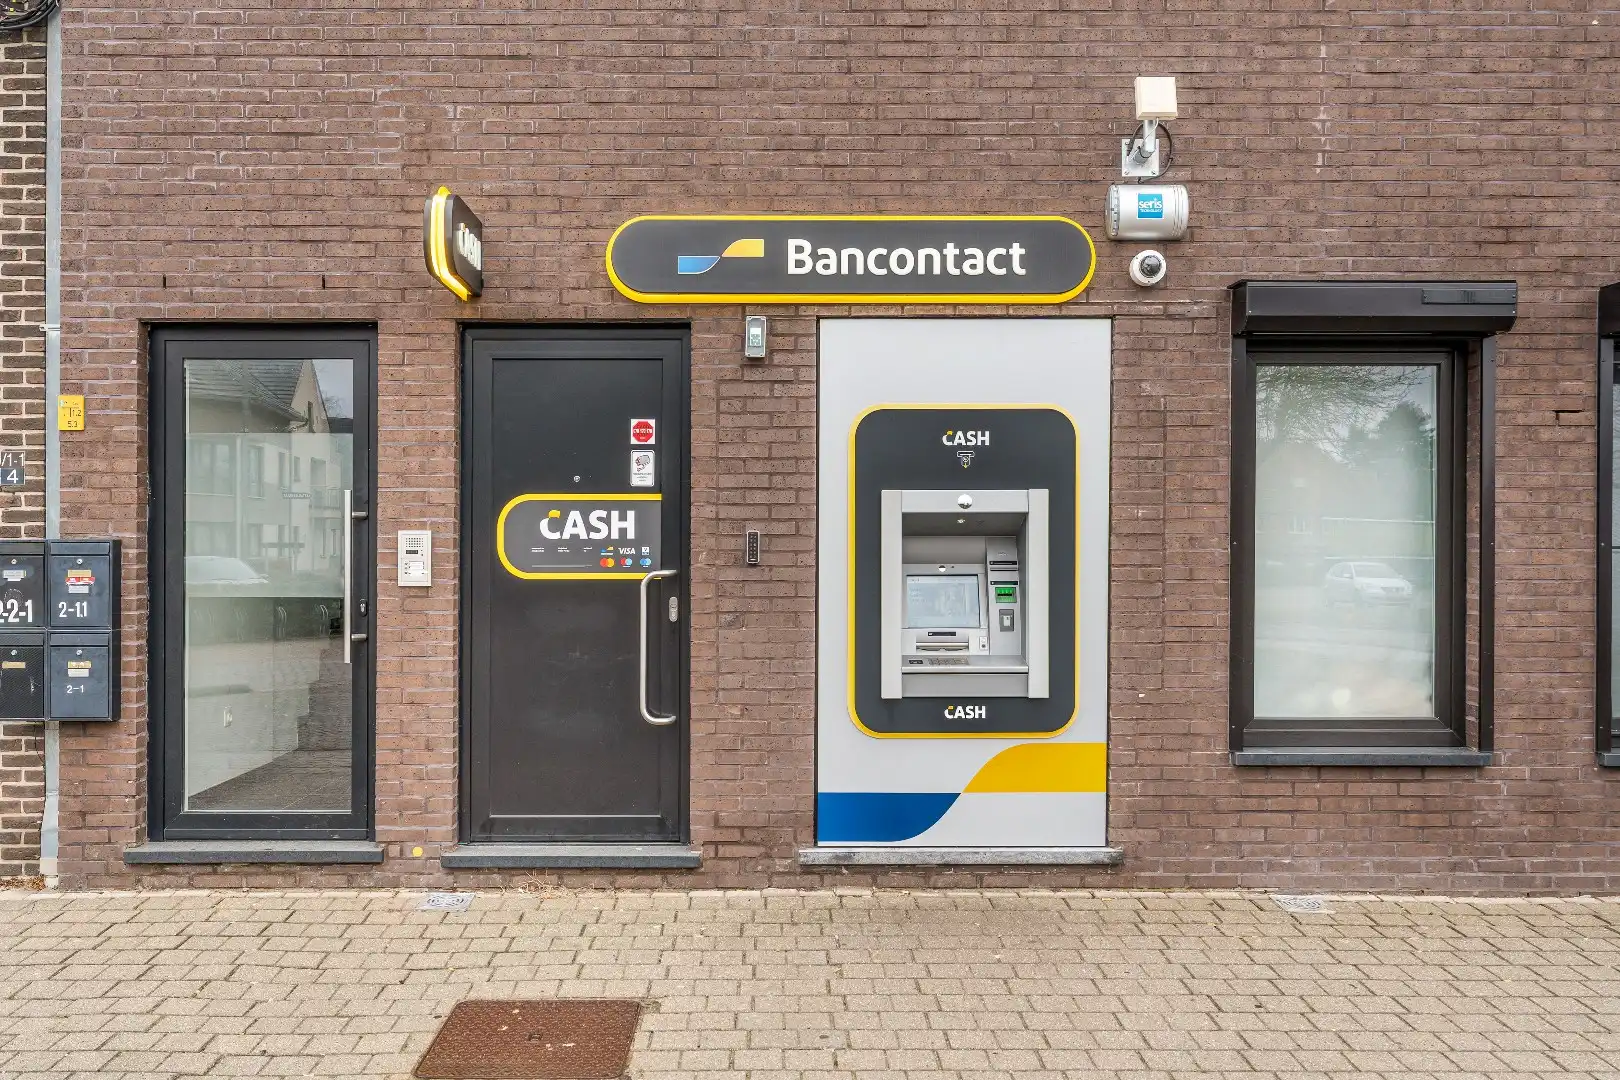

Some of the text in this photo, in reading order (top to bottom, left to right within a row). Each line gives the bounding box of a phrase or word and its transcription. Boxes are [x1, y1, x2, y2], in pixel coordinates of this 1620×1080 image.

[1138, 197, 1162, 209] seris
[786, 238, 1026, 276] Bancontact
[942, 430, 990, 446] CASH
[539, 509, 635, 540] CASH
[66, 684, 84, 694] 2-1
[943, 705, 986, 719] CASH
